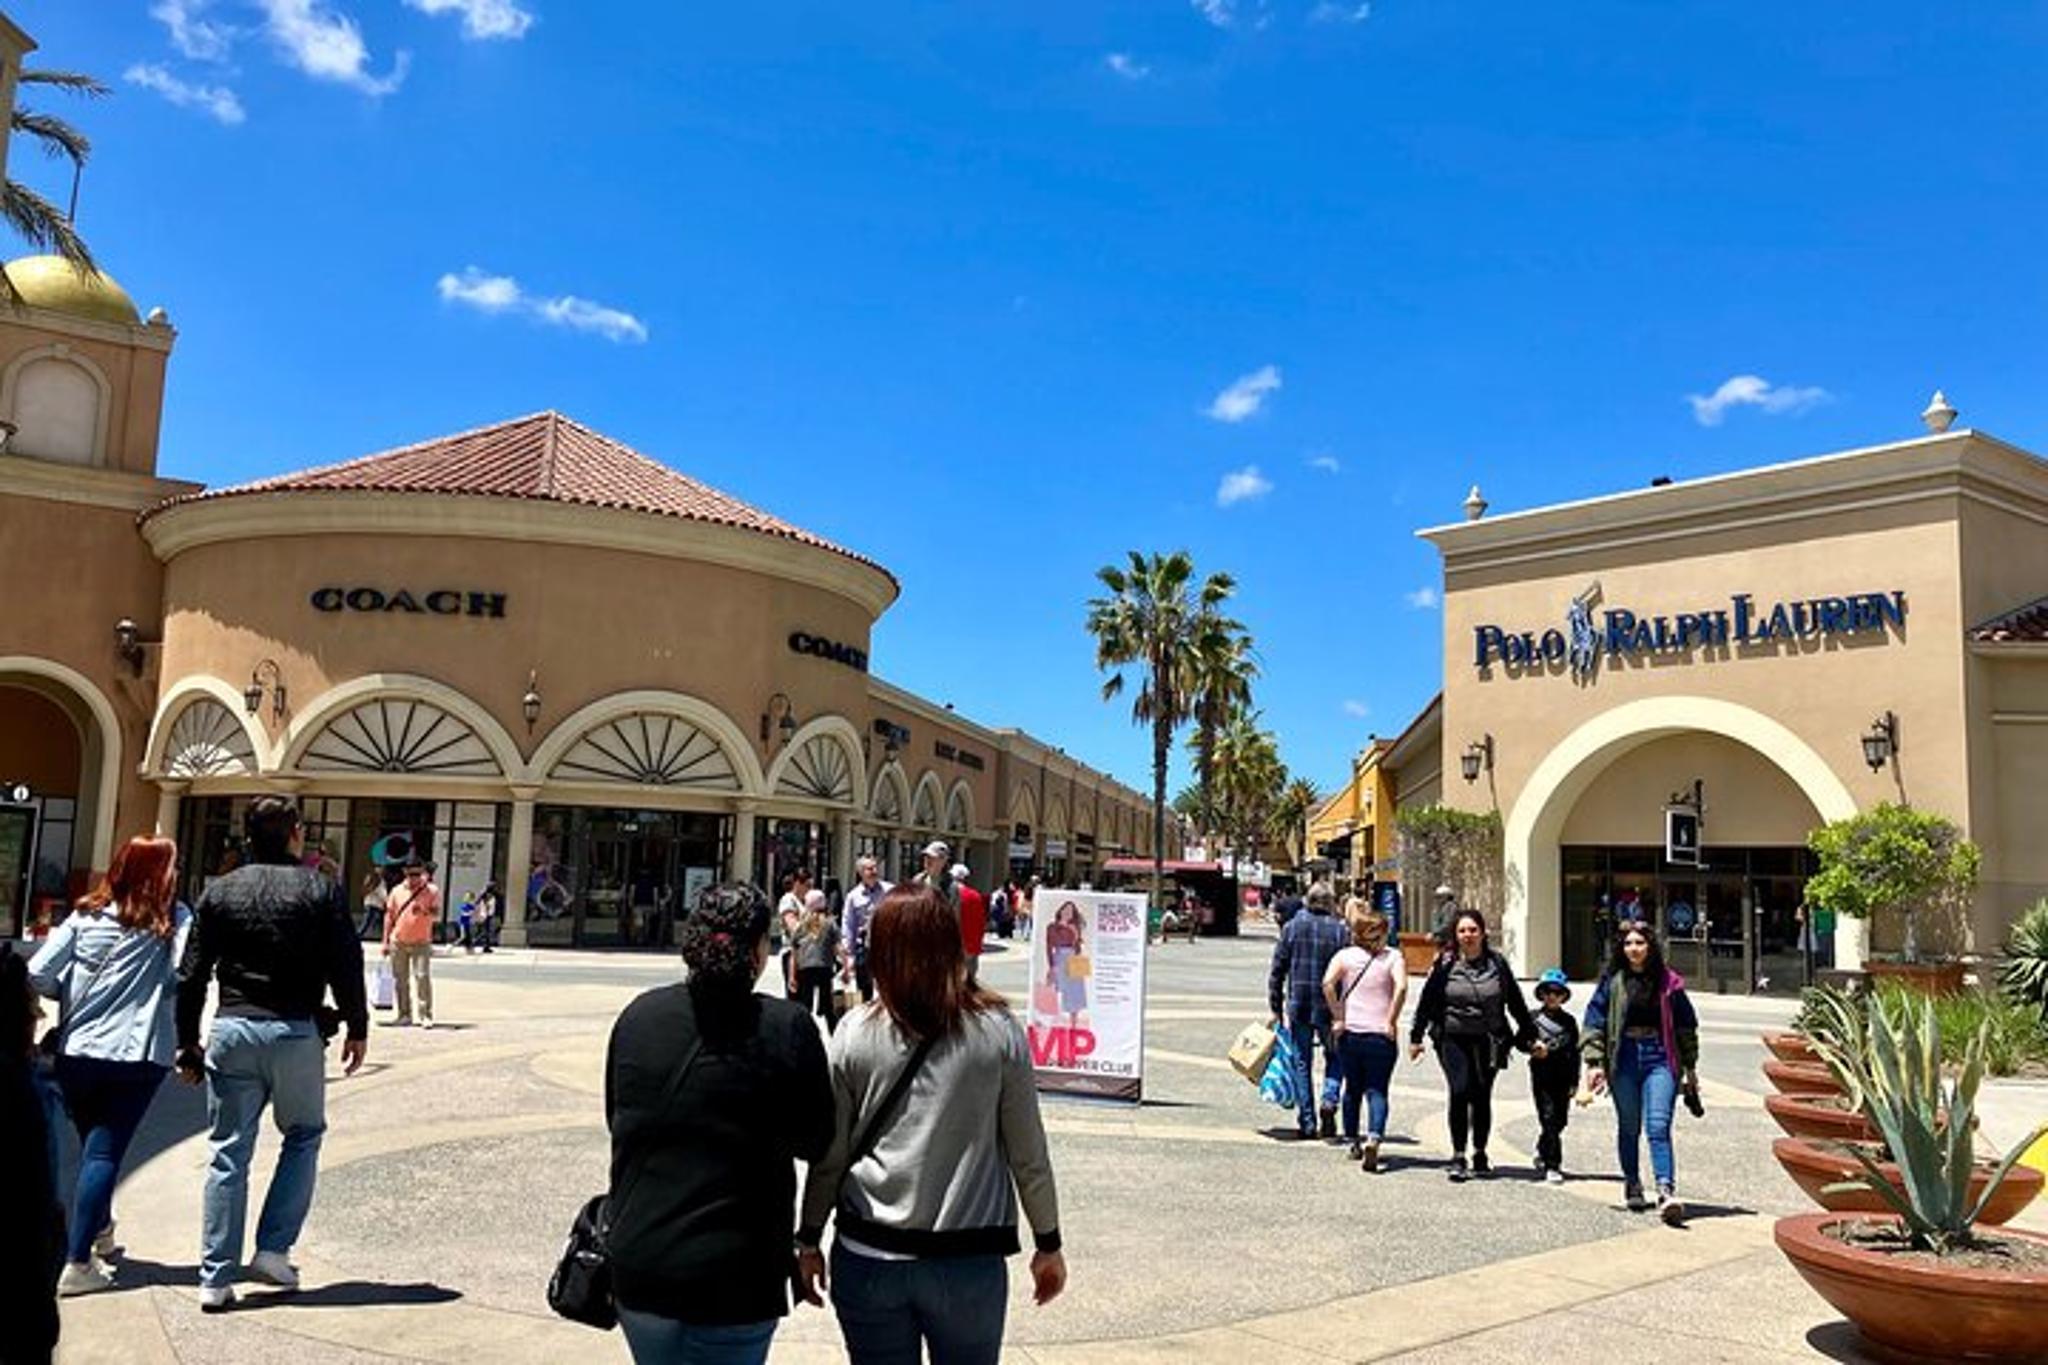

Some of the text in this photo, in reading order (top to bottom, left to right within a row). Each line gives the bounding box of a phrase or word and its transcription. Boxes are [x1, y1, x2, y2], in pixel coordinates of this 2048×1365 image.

[310, 587, 508, 618] COACH
[1474, 591, 1906, 667] POLO RALPH LAUREN
[1027, 1025, 1096, 1068] VIP
